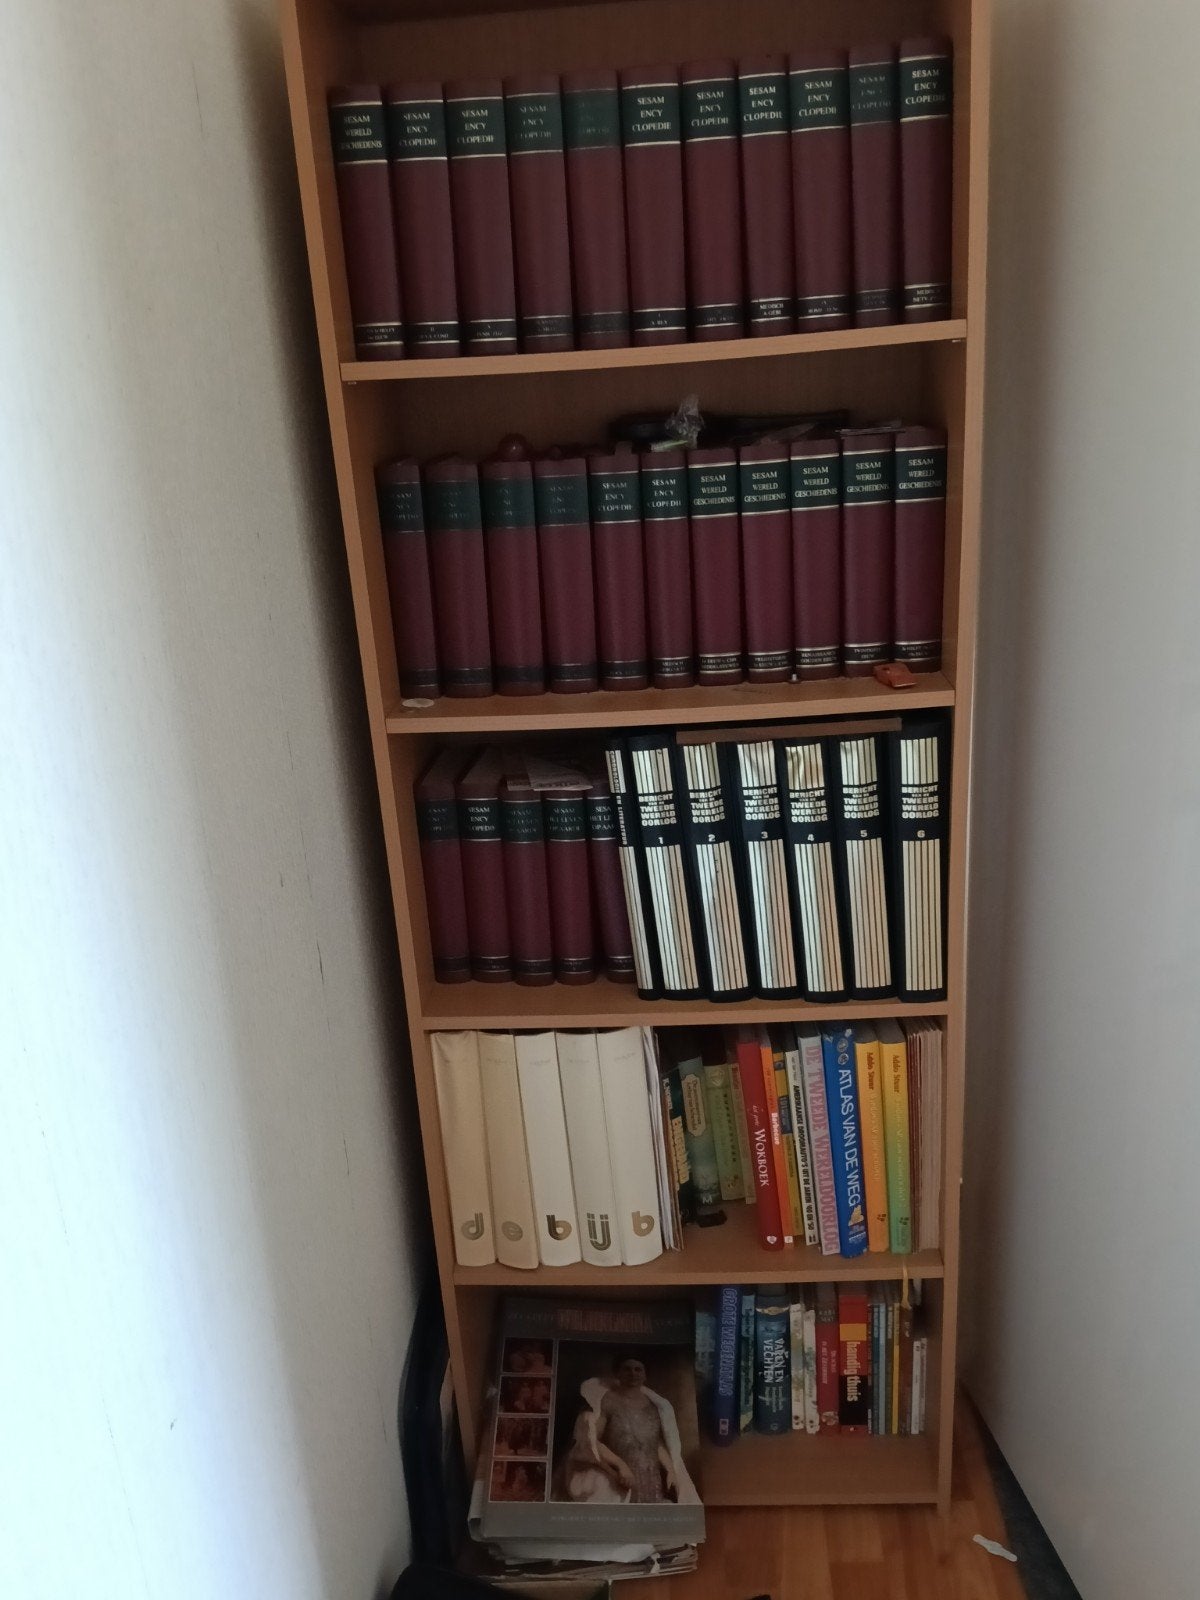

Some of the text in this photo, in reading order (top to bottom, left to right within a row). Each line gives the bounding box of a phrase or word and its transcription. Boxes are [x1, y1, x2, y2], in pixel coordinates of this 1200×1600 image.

[912, 69, 939, 79] SESAM
[805, 81, 833, 89] SESAM
[914, 82, 937, 91] ENCY
[749, 86, 777, 95] SESAM
[697, 91, 724, 100] SESAM
[808, 93, 831, 102] ENCY
[637, 96, 665, 105] SESAM
[752, 99, 775, 108] ENCY
[700, 104, 722, 113] ENCY
[404, 112, 430, 120] SESAM
[461, 109, 489, 118] SESAM
[640, 109, 663, 118] ENCY
[743, 111, 783, 122] CLOPEDIE
[407, 125, 428, 133] ENCY
[465, 123, 487, 131] ENCY
[632, 122, 672, 132] CLOPEDIE
[855, 461, 882, 470] SESAM
[908, 458, 934, 466] SESAM
[802, 466, 829, 475] SESAM
[908, 470, 935, 478] WERELD
[700, 474, 726, 483] SESAM
[752, 471, 778, 480] SESAM
[855, 472, 882, 481] WERELD
[602, 481, 627, 489] SESAM
[803, 477, 830, 486] WERELD
[702, 486, 728, 494] WERELD
[752, 482, 779, 491] WERELD
[846, 483, 890, 493] GESCHIEDENIS
[794, 487, 838, 498] GESCHIEDENIS
[693, 496, 736, 506] GESCHIEDENIS
[744, 493, 787, 503] GESCHIEDENIS
[690, 788, 721, 798] BERICHT
[743, 787, 777, 796] BERICHT
[843, 784, 877, 793] BERICHT
[902, 785, 938, 793] BERICHT
[639, 793, 673, 802] BERICHT
[789, 789, 825, 798] BERICHT
[691, 799, 723, 809] TWEEDE
[744, 798, 778, 806] TWEEDE
[790, 800, 826, 808] TWEEDE
[844, 795, 878, 804] TWEEDE
[902, 796, 938, 804] TWEEDE
[640, 804, 675, 812] TWEEDE
[692, 806, 724, 815] WERELD
[745, 804, 780, 813] WERELD
[791, 807, 827, 815] WERELD
[844, 802, 879, 811] WERELD
[902, 803, 939, 811] WERELD
[641, 811, 676, 819] WERELD
[693, 813, 725, 823] OORLOG
[745, 811, 780, 820] OORLOG
[844, 809, 879, 818] OORLOG
[902, 809, 939, 818] OORLOG
[642, 817, 677, 826] OORLOG
[791, 814, 828, 823] OORLOG
[708, 834, 715, 842] 2
[761, 831, 768, 839] 3
[917, 830, 925, 838] 6
[658, 836, 664, 844] 1
[771, 1112, 780, 1146] Barbecue
[839, 1069, 861, 1206] ATLAS VAN DE WEG
[806, 1046, 838, 1252] DE TWEEDE WERELDOORLOG
[754, 1128, 770, 1187] WOKBOEK
[461, 1212, 485, 1241] d
[546, 1214, 573, 1241] b
[631, 1210, 655, 1237] b
[501, 1220, 524, 1242] e
[719, 1288, 738, 1396] GROTE WEGENATLAS
[763, 1340, 774, 1383] VECHTEN
[775, 1338, 786, 1382] VAREN EN
[844, 1342, 861, 1401] handig thuis
